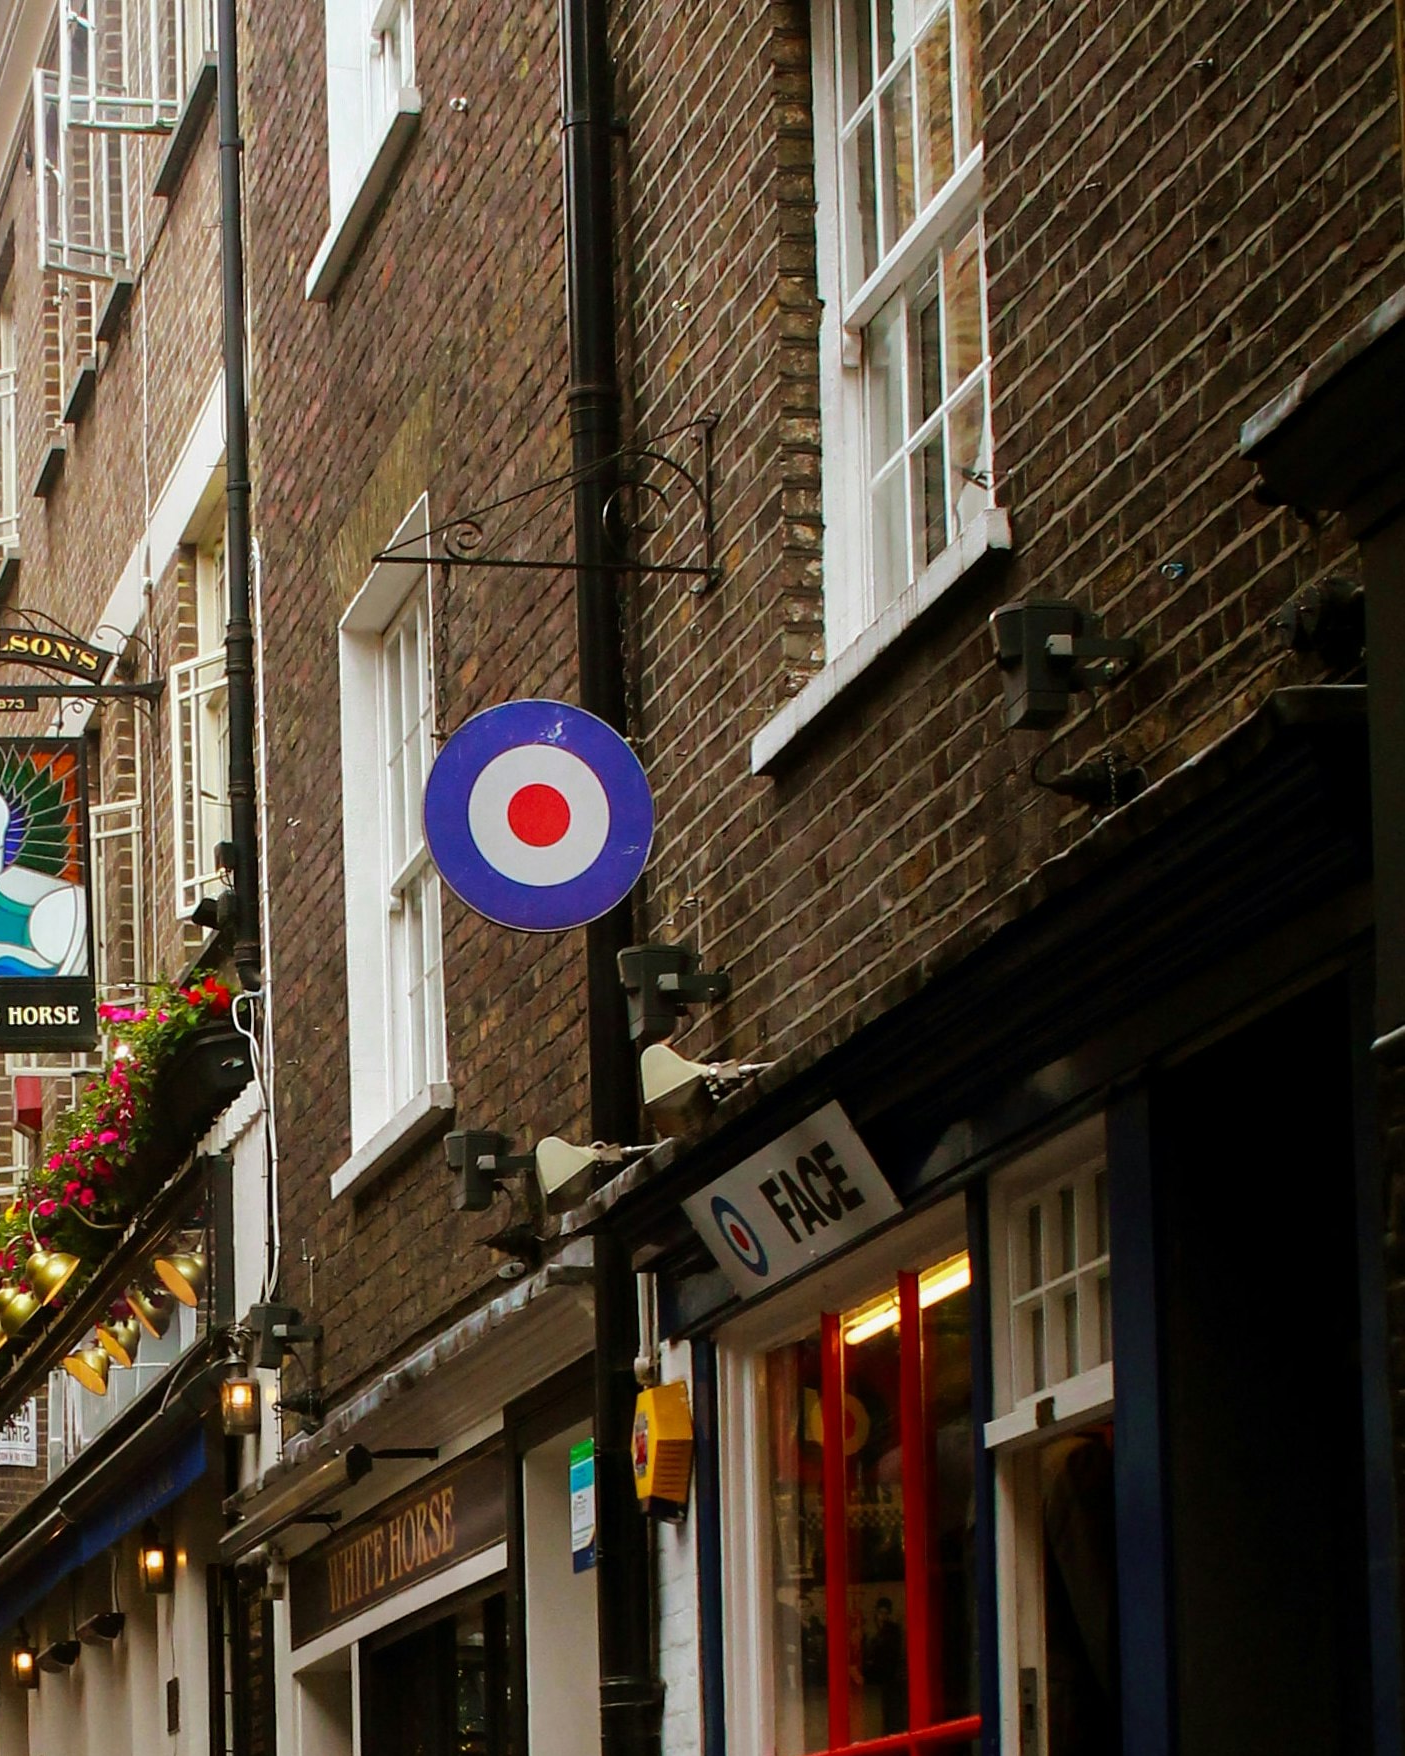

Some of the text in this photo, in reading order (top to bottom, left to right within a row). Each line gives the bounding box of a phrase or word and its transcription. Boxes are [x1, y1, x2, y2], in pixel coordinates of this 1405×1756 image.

[8, 1006, 79, 1025] HORSE
[759, 1140, 866, 1244] FACE
[327, 1486, 456, 1614] WHITE HORSE
